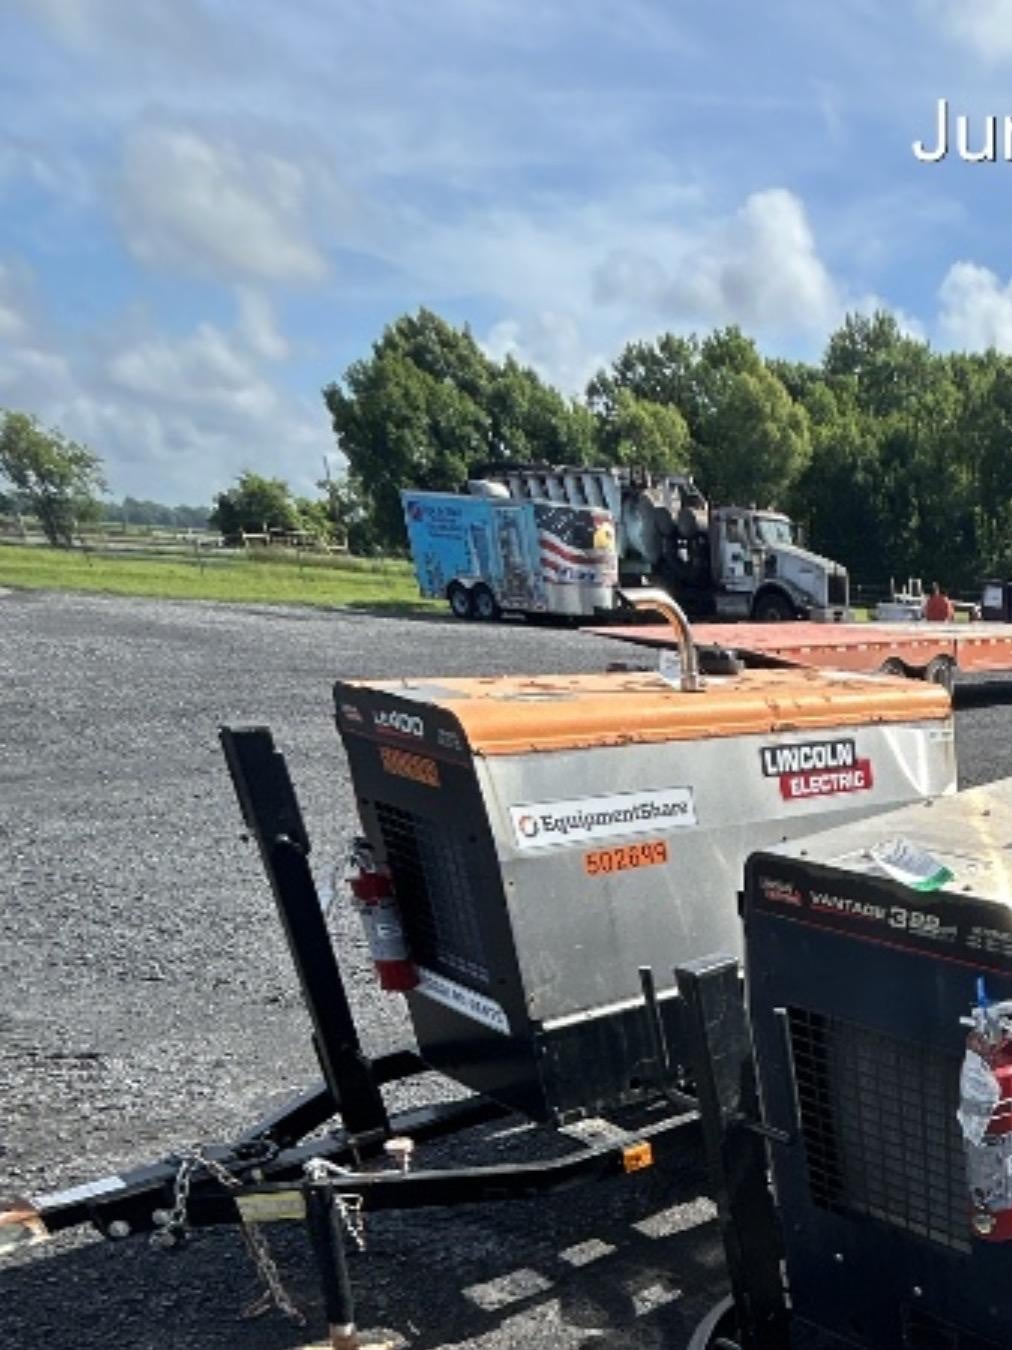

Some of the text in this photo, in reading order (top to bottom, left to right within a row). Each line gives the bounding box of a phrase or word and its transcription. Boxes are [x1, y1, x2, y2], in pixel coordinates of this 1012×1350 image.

[763, 742, 853, 775] LINCOLN
[790, 769, 866, 797] ELECTRIC
[540, 801, 688, 834] EquipmentShare
